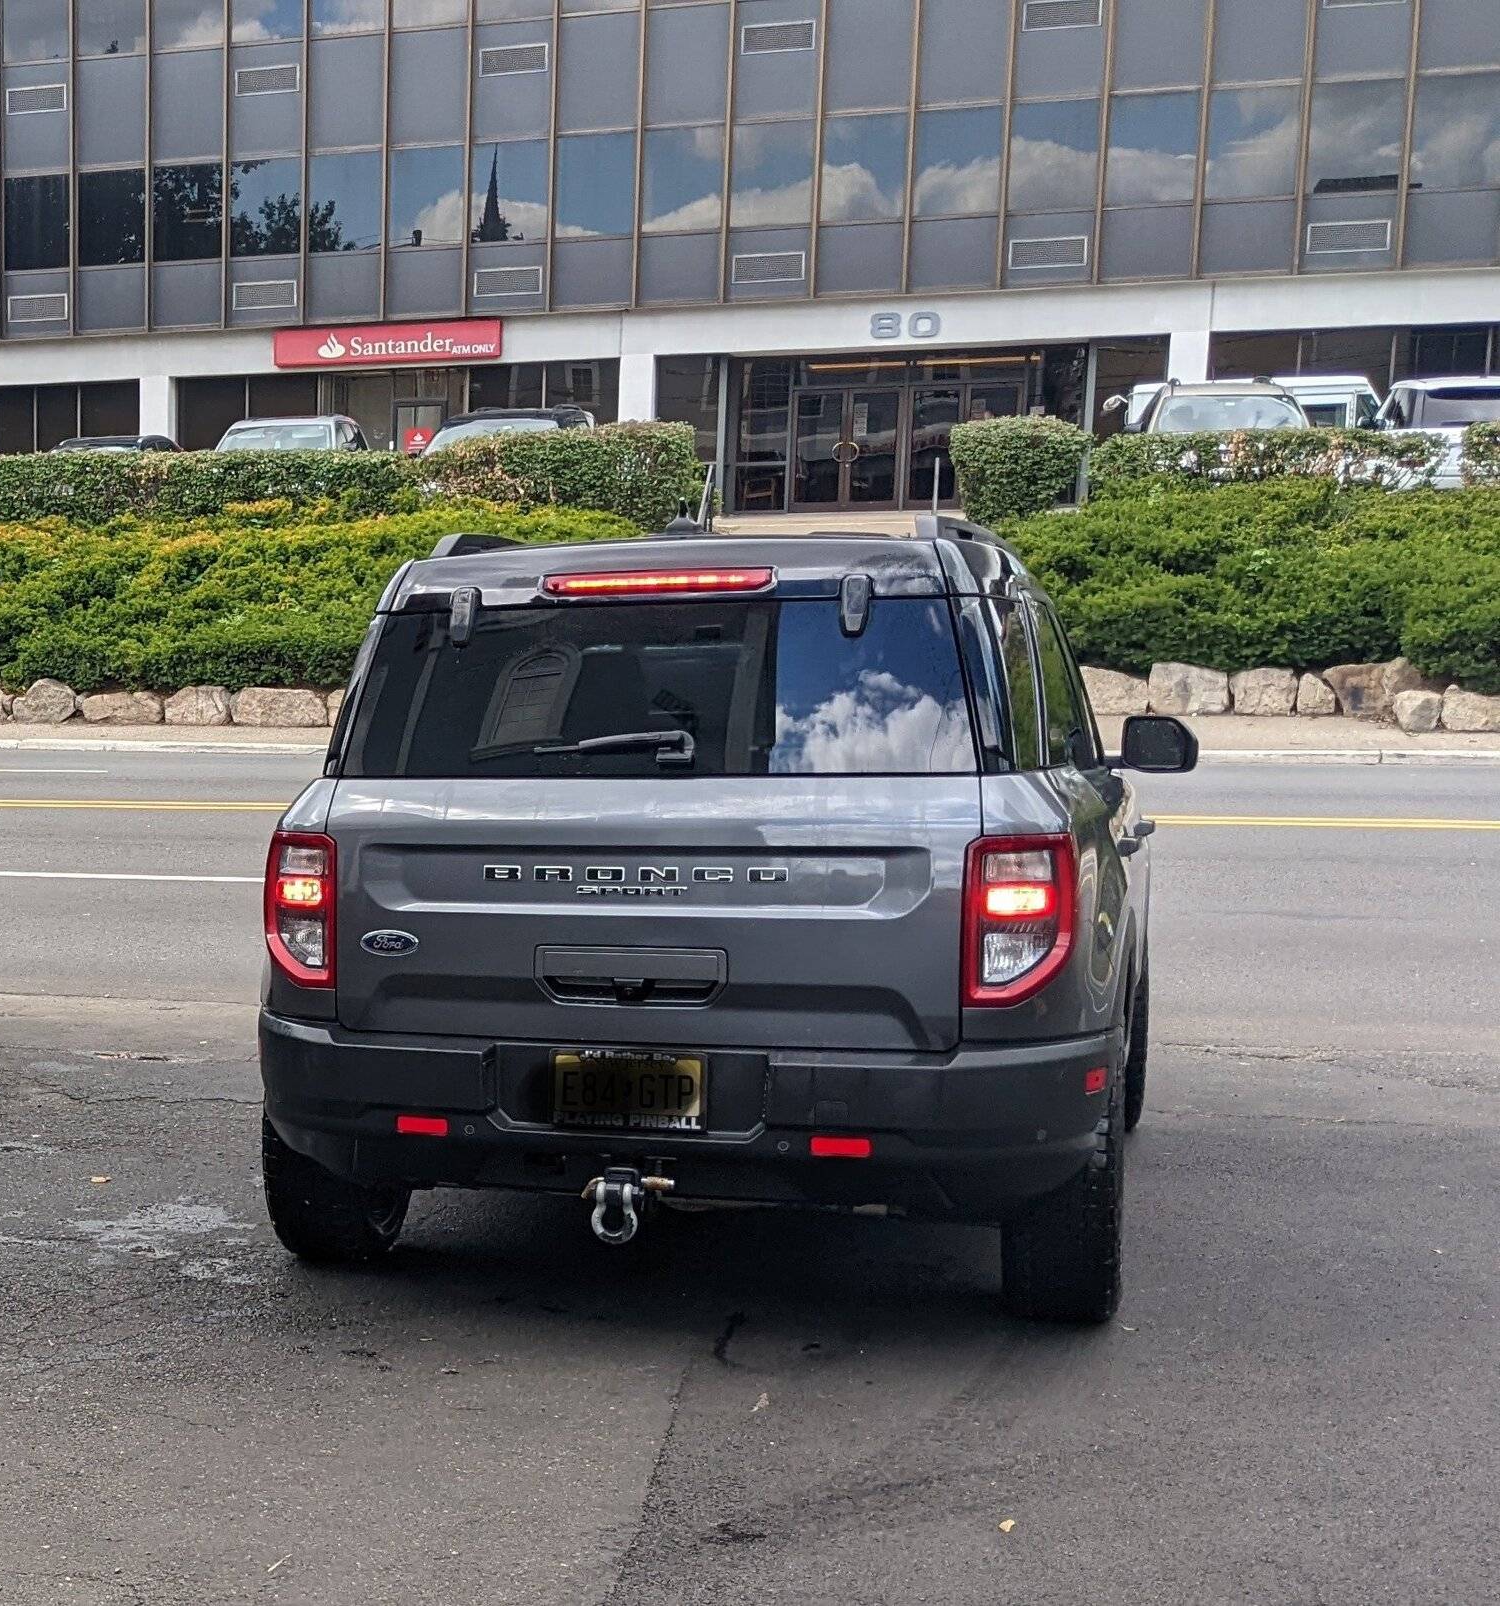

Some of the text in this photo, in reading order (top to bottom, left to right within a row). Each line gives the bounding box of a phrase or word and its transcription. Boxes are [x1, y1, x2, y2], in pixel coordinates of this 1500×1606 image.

[870, 312, 942, 338] 80
[349, 331, 496, 357] Santander ATM ONLY
[483, 864, 790, 883] BRONCO
[575, 885, 689, 897] SPORT
[372, 934, 406, 950] Ford
[553, 1111, 702, 1130] PLAYING PINBALL
